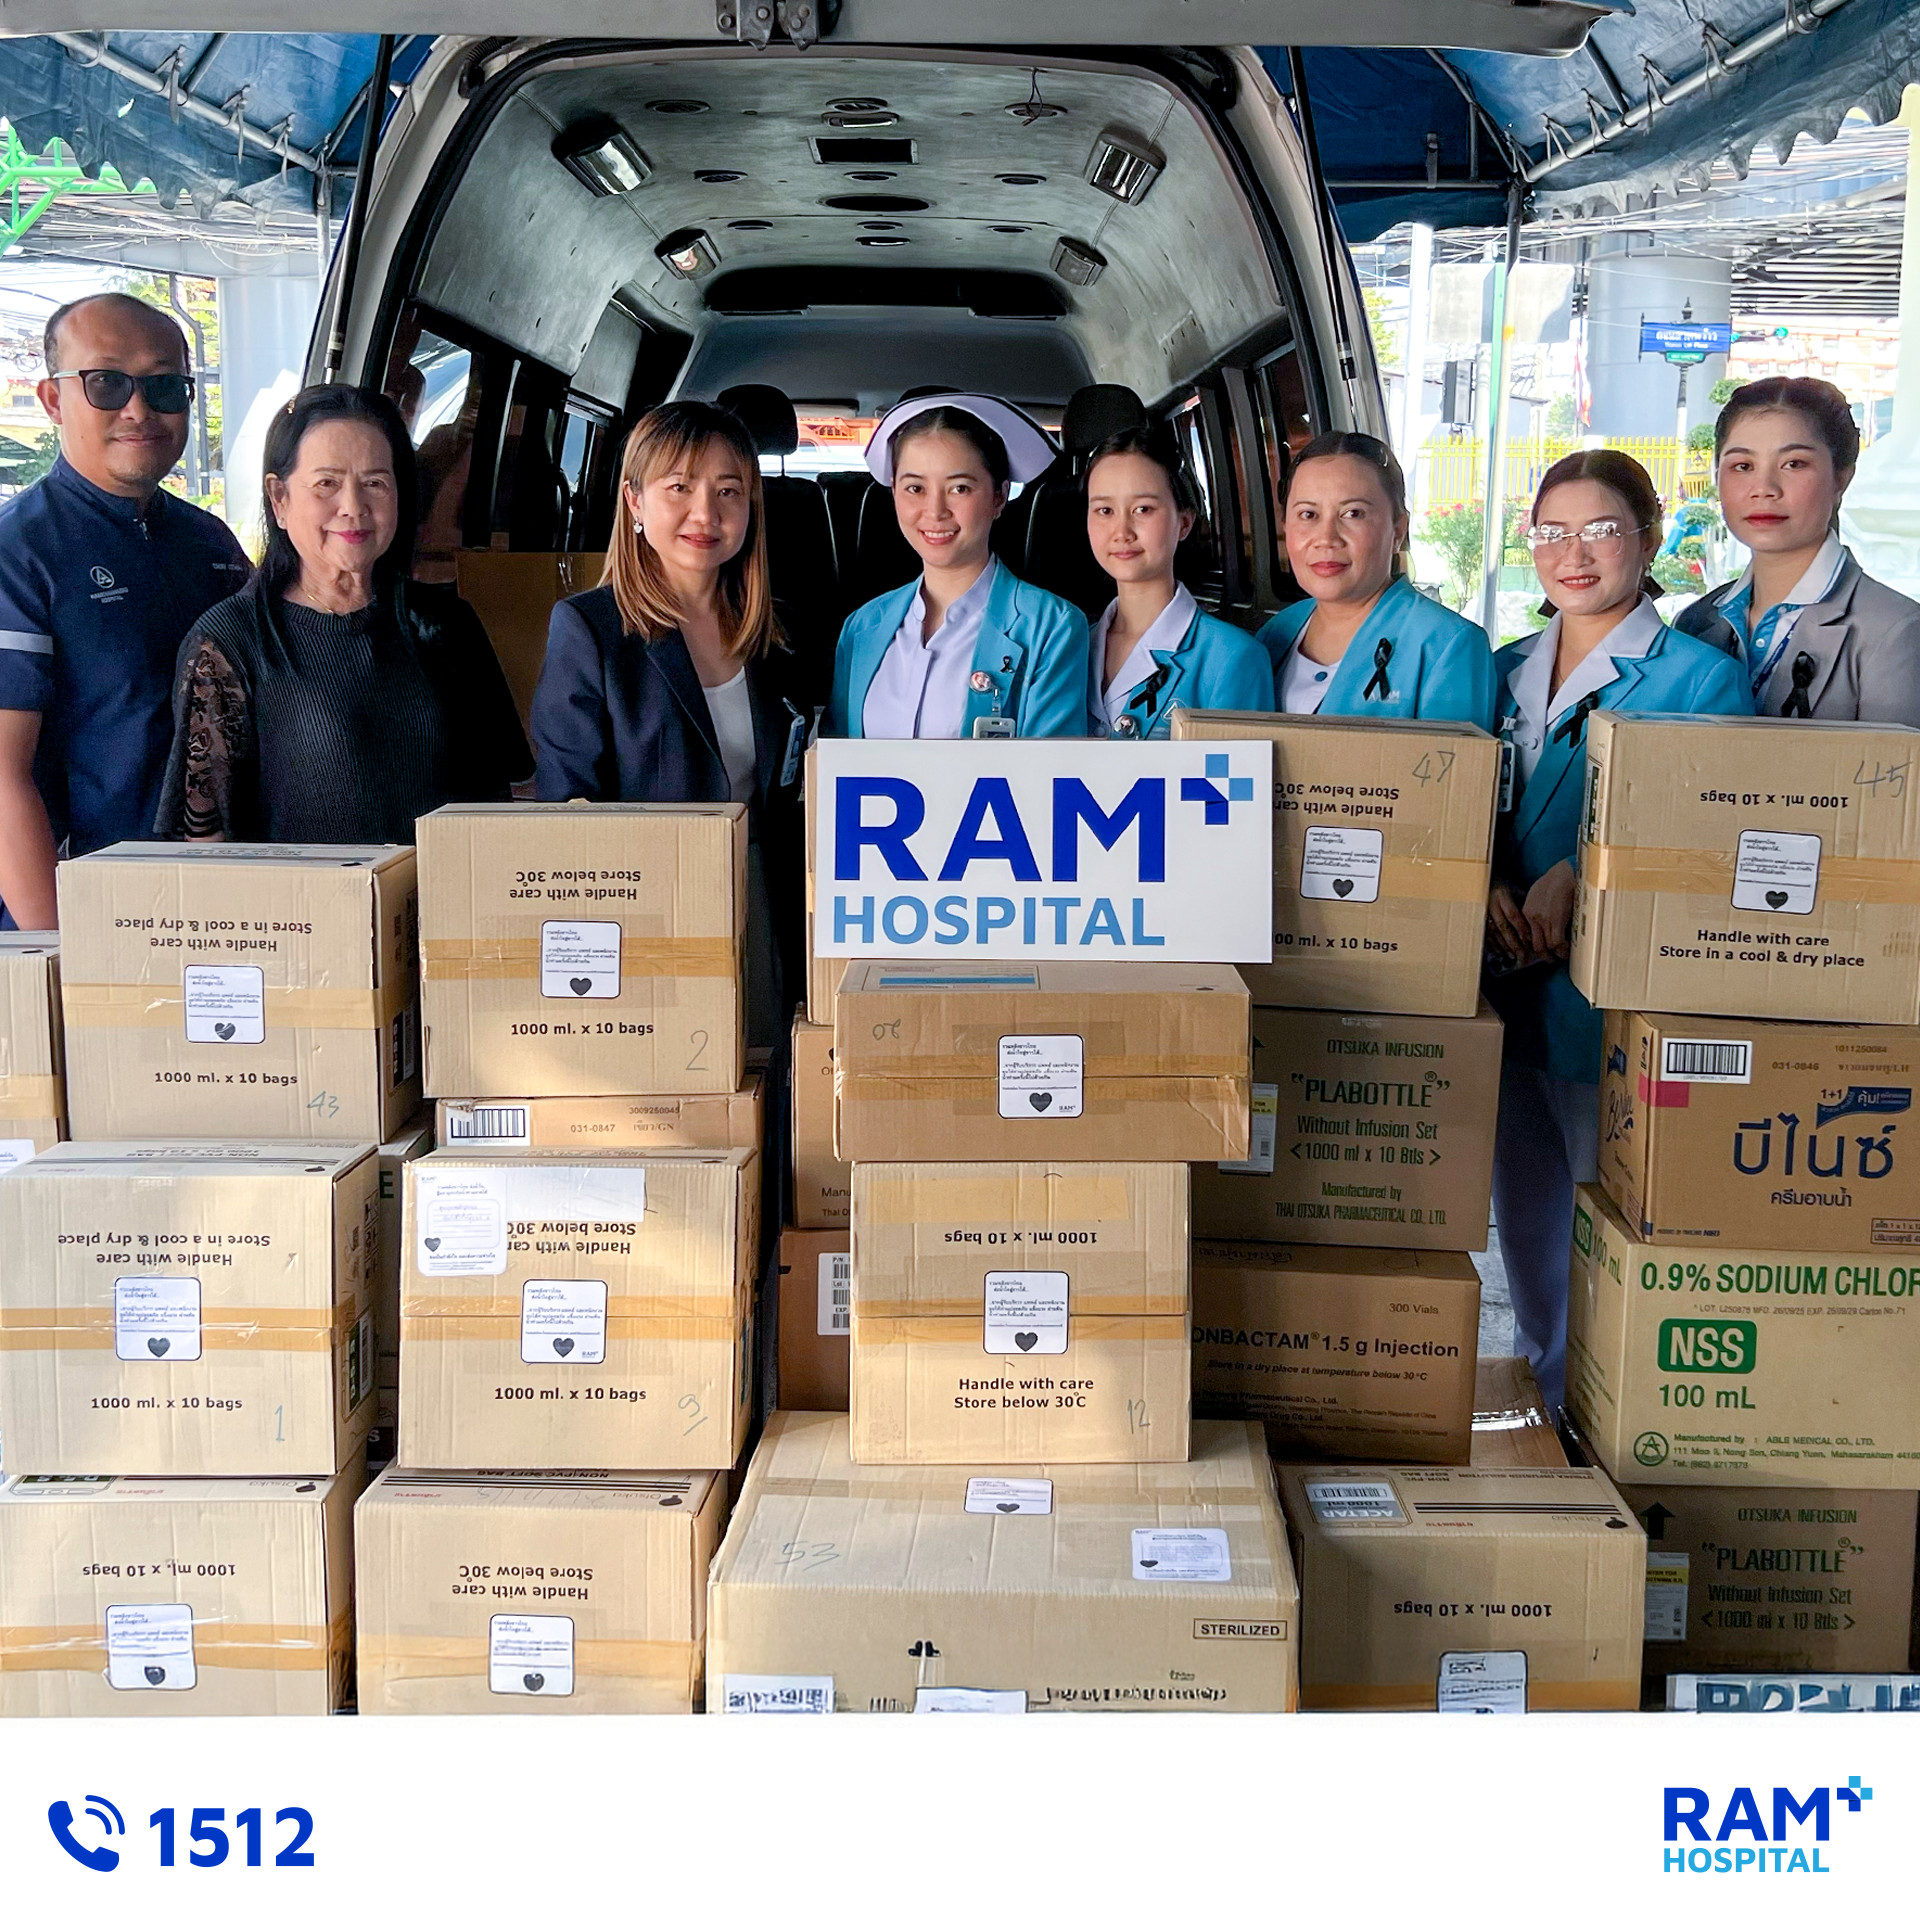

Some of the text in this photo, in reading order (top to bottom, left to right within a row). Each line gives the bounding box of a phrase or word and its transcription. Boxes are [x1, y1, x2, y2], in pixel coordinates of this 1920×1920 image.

[1412, 750, 1455, 788] 47
[1852, 759, 1914, 799] 45
[1308, 784, 1355, 799] below
[1360, 787, 1399, 800] Store
[1699, 789, 1849, 809] 1000 ml. x 10 bags
[834, 777, 1165, 883] RAM
[515, 870, 641, 888] Store below 30°C
[509, 885, 638, 902] Handle with care
[114, 917, 313, 935] Store in a cool & dry place
[833, 896, 1165, 946] HOSPITAL
[150, 937, 278, 953] Handle with care
[1697, 930, 1830, 947] Handle with care
[1659, 945, 1865, 967] Store in a cool & dry place
[511, 1021, 654, 1037] 1000 ml. x 10 bags
[684, 1030, 710, 1072] 2
[1327, 1039, 1444, 1058] OTSUKA INFUSION
[154, 1071, 298, 1087] 1000 ml. x 10 bags
[1821, 1088, 1842, 1099] 1+1
[570, 1124, 616, 1133] 031-0847
[1297, 1115, 1438, 1139] Without Infusion Set
[1733, 1112, 1896, 1179] บีไนซ์
[1321, 1182, 1402, 1201] Manufactured by
[1770, 1187, 1852, 1208] ครีมอาบน้ำ
[1275, 1202, 1294, 1217] THAI
[1297, 1204, 1330, 1219] OTSUKA
[1333, 1205, 1406, 1222] PHARMACEUTICAL
[57, 1231, 271, 1248] Store in a cool & dry place
[944, 1229, 1097, 1246] 1000 ml. x 10 bags
[96, 1253, 233, 1267] Handle with care
[1641, 1262, 1711, 1292] 0.9%
[1716, 1264, 1827, 1296] SODIUM
[1389, 1303, 1439, 1315] 300 Vials
[1191, 1326, 1459, 1358] ONBACTAM® 1.5 g Injection
[1669, 1326, 1745, 1368] NSS
[1254, 1362, 1271, 1375] dry
[1271, 1363, 1299, 1376] place
[1301, 1365, 1310, 1374] at
[1312, 1366, 1370, 1380] temperature
[1372, 1368, 1401, 1380] below
[959, 1376, 1094, 1391] Handle with care
[494, 1386, 647, 1403] 1000 ml. x 10 bags
[954, 1391, 1087, 1409] Store below 30°C
[1658, 1384, 1756, 1409] 100 mL
[91, 1396, 243, 1412] 1000 ml. x 10 bags
[1674, 1433, 1731, 1443] Manufactured
[1766, 1436, 1790, 1444] ABLE
[1792, 1437, 1832, 1445] MEDICAL
[1738, 1507, 1857, 1523] OTSUKA INFUSION
[458, 1565, 594, 1583] Store below 30°C
[451, 1584, 589, 1601] Handle with care
[1708, 1583, 1852, 1605] Without Infusion Set
[1393, 1600, 1553, 1618] 1000 ml. x 10 bags
[1200, 1623, 1280, 1637] STERILIZED
